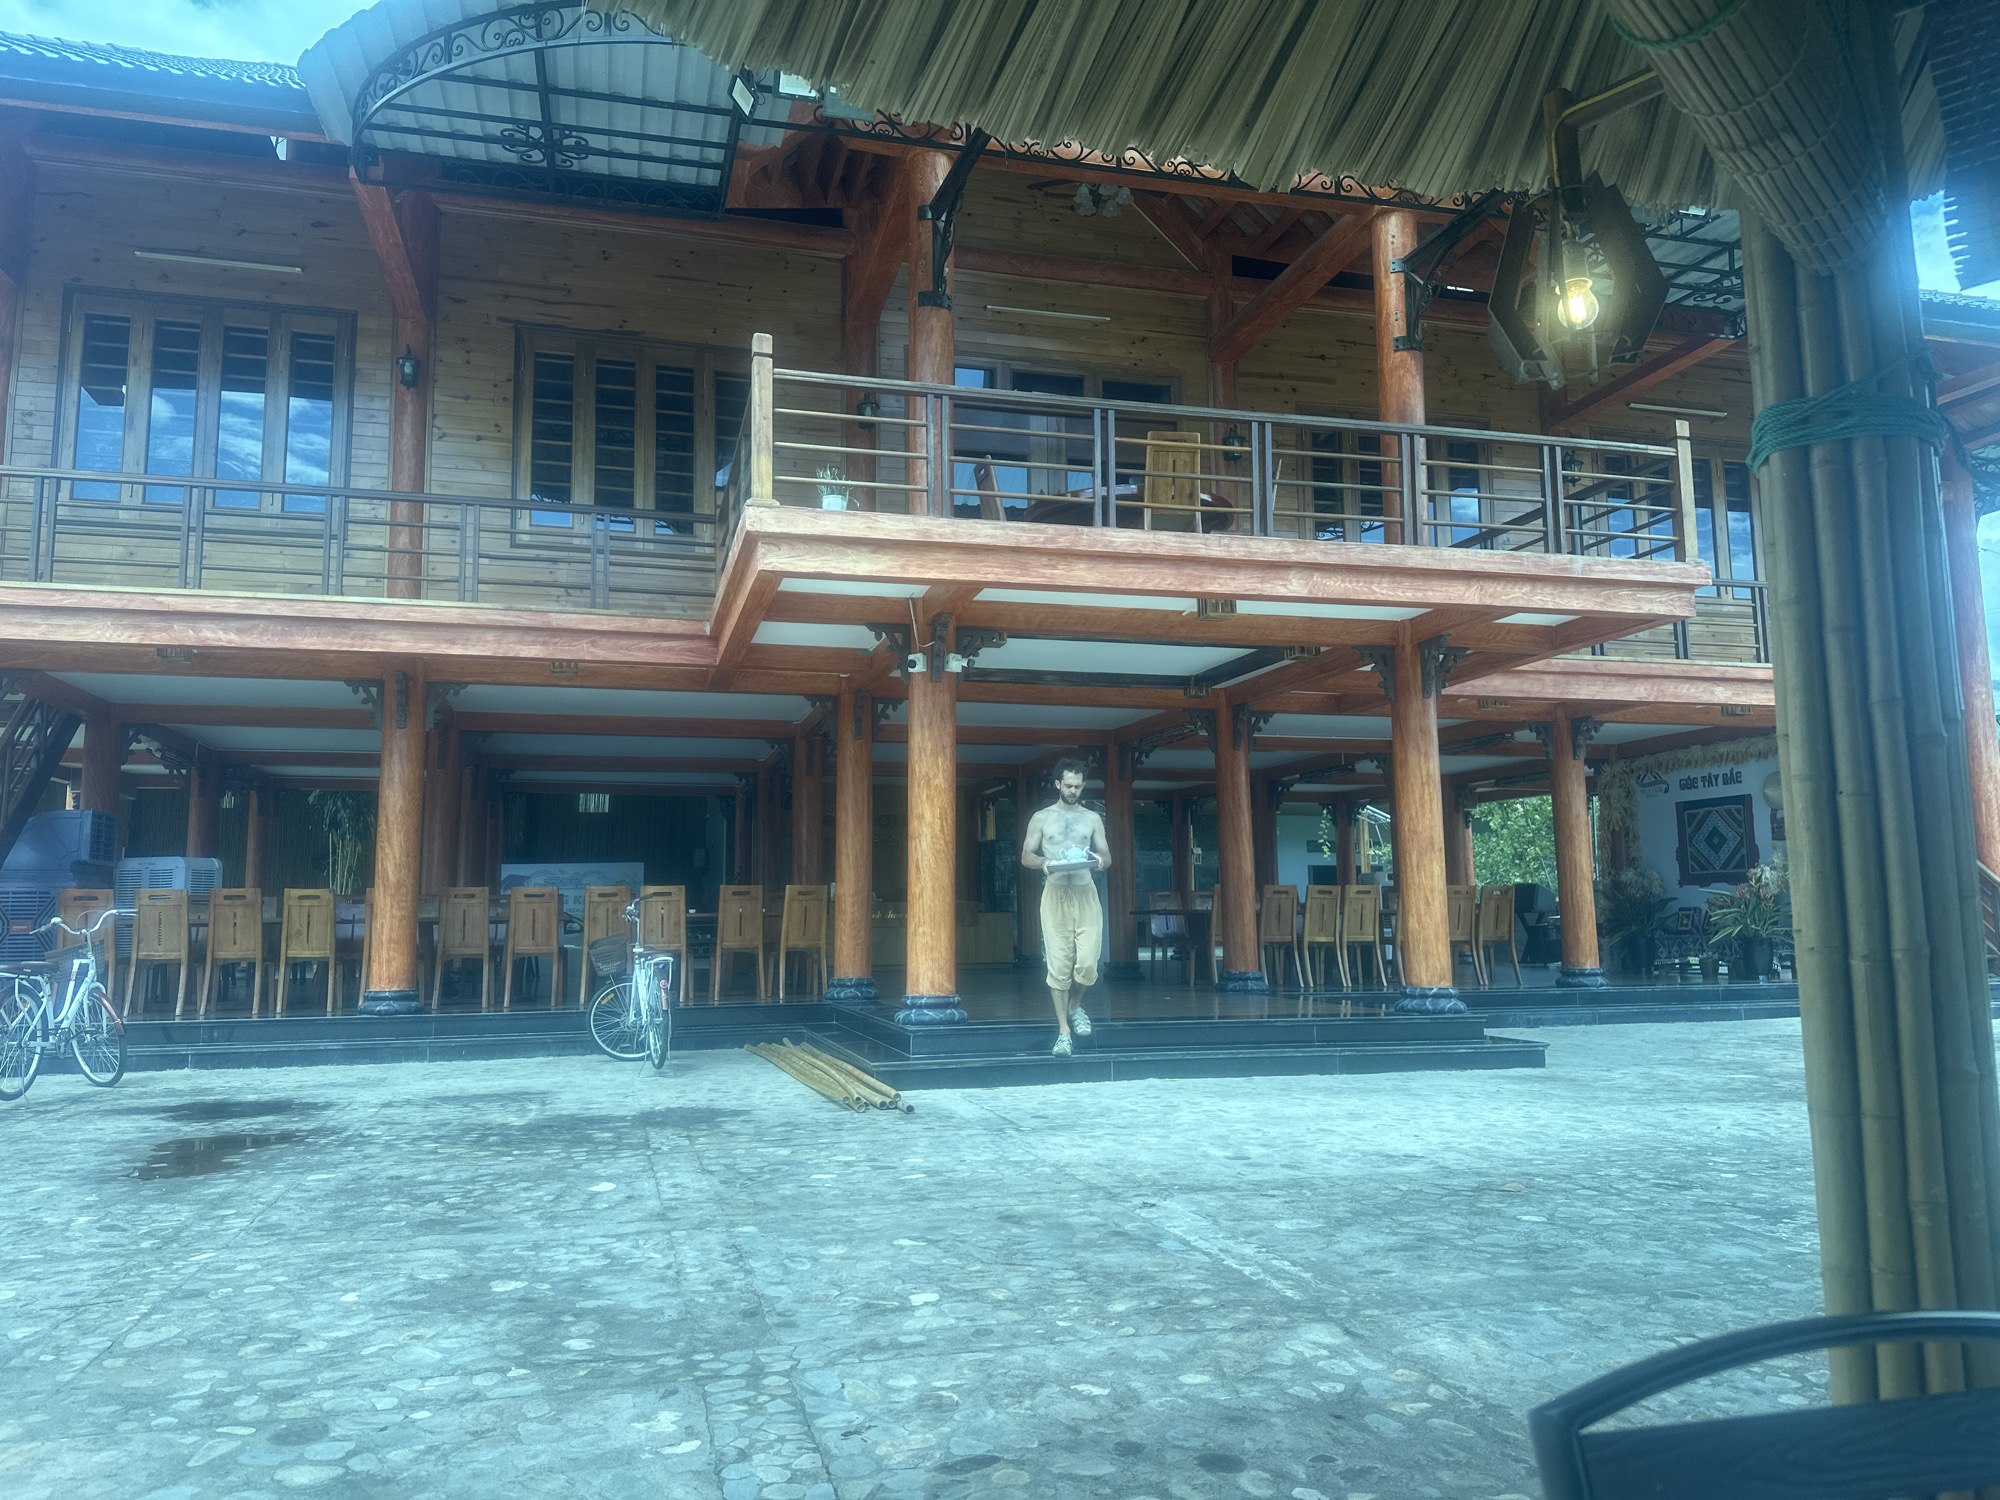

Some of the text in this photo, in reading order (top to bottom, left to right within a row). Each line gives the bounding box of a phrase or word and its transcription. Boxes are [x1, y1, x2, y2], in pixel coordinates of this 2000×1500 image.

[1679, 775, 1699, 791] GÓC
[1700, 772, 1720, 788] TÂY
[1722, 767, 1742, 786] BẮC
